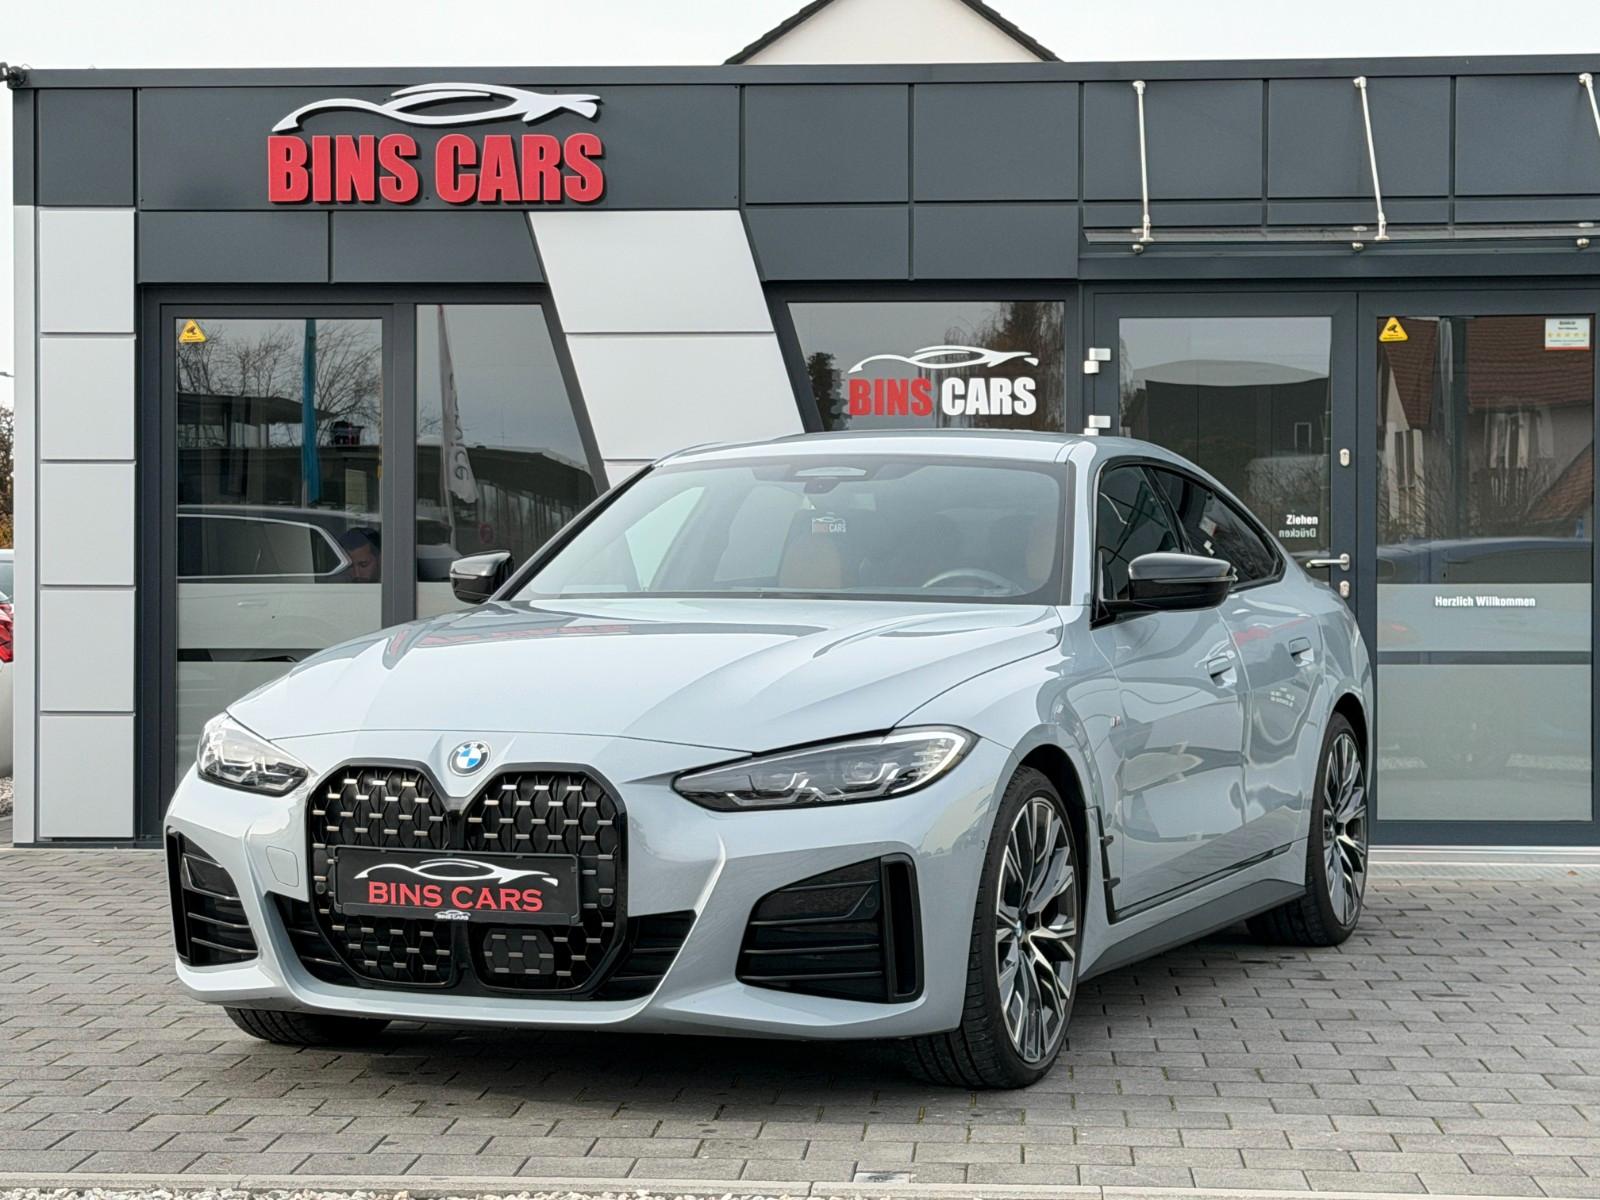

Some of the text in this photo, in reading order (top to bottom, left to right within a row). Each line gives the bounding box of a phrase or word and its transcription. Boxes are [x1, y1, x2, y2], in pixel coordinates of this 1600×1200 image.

[268, 133, 604, 203] BINS CARS
[848, 377, 1037, 416] BINS CARS
[1286, 514, 1319, 525] Ziehen
[1435, 596, 1536, 607] Herzlich Willkommen
[368, 881, 543, 912] BINS CARS
